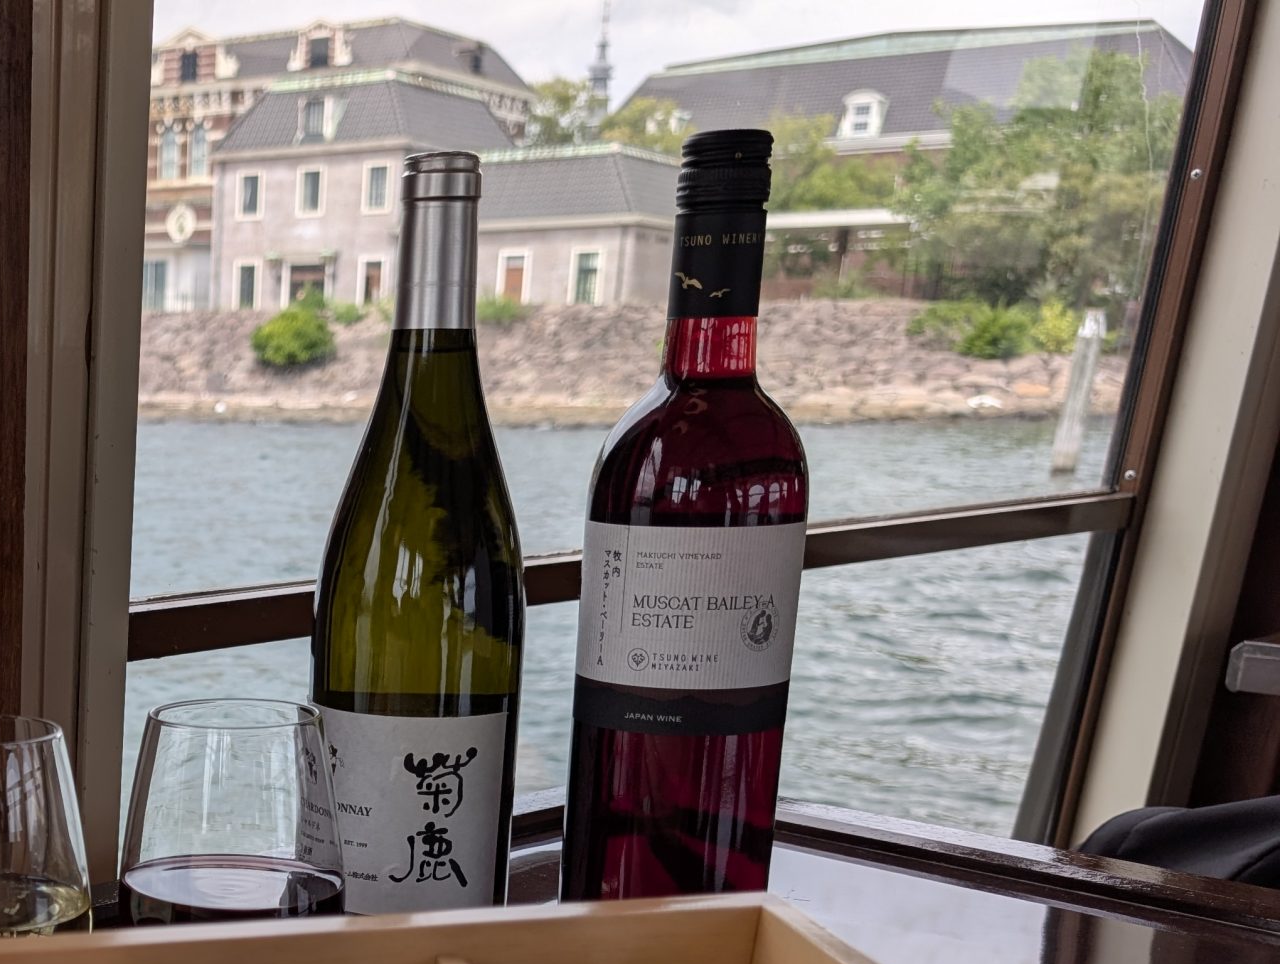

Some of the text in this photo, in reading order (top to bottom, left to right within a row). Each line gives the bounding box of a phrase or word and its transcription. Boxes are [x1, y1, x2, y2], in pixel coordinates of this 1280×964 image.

[679, 552, 722, 561] VINEYARD
[636, 561, 664, 570] ESTATE
[632, 594, 702, 611] MUSCAT
[631, 612, 695, 629] ESTATE
[652, 652, 719, 663] TSUNO WINE
[651, 663, 700, 672] MIYAZAKI
[624, 711, 683, 723] JAPAN WINE
